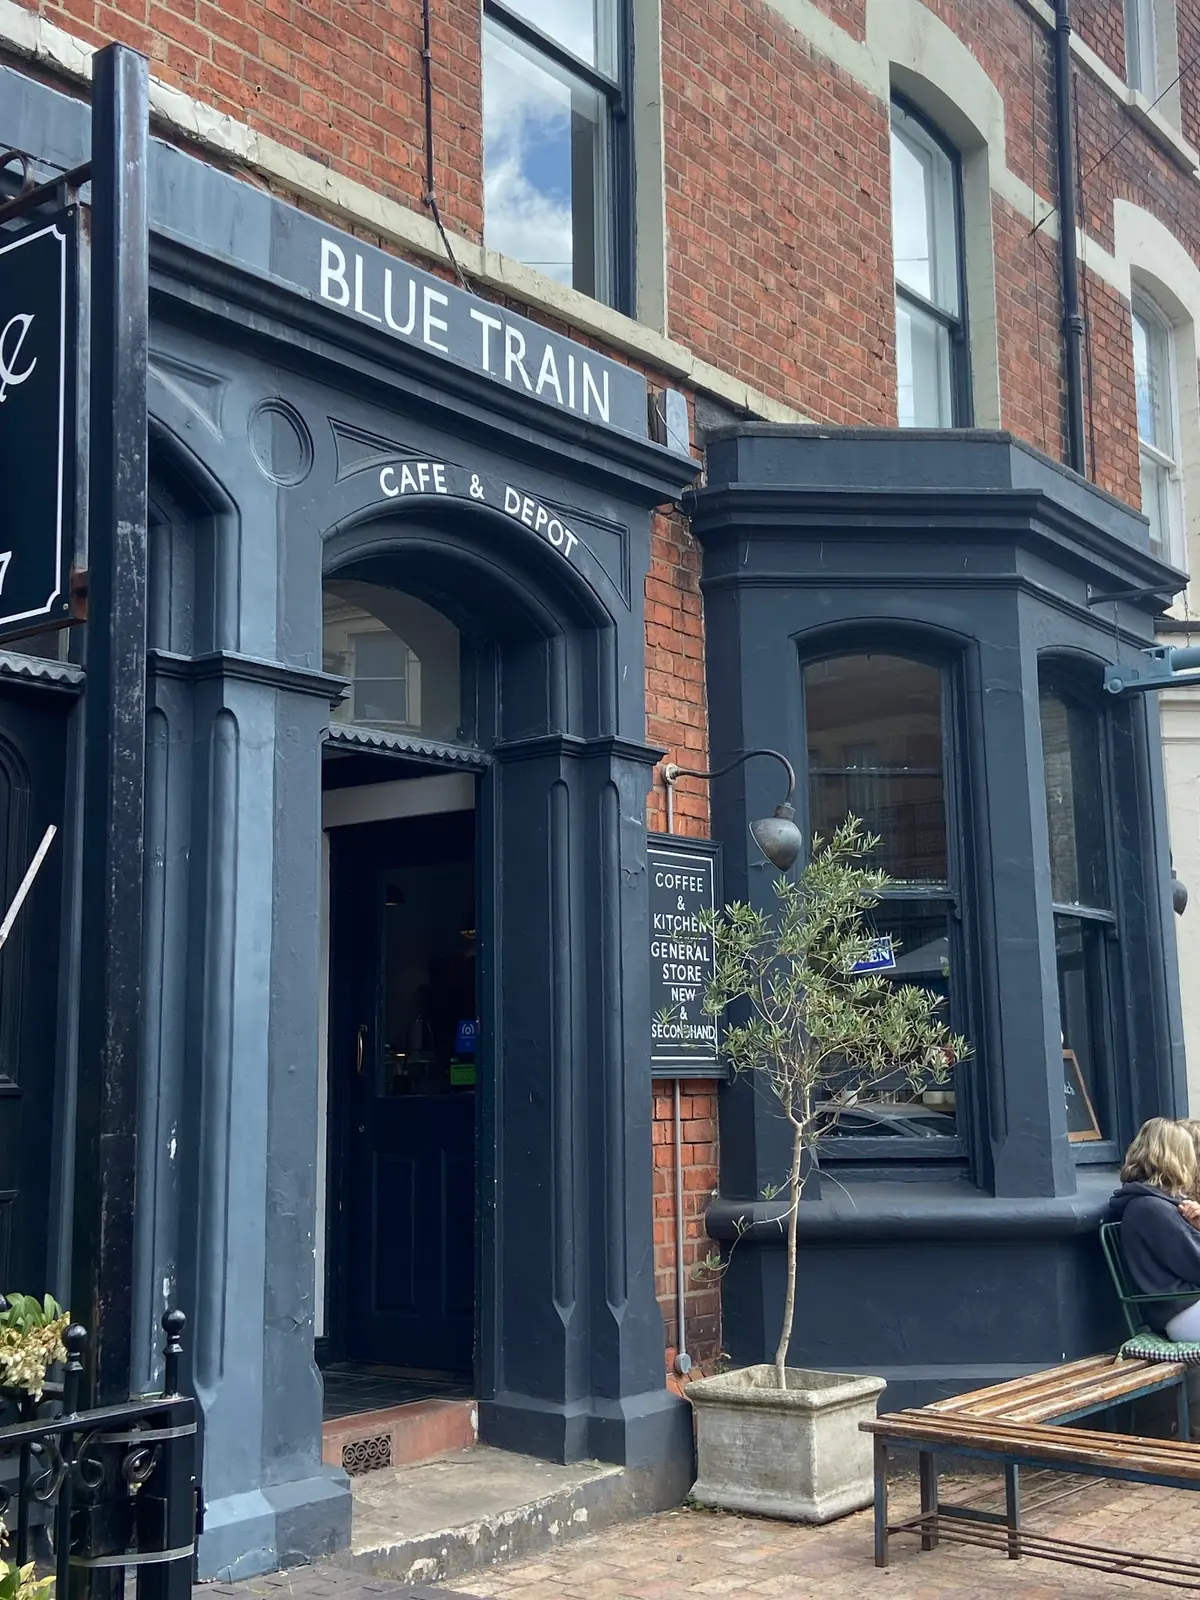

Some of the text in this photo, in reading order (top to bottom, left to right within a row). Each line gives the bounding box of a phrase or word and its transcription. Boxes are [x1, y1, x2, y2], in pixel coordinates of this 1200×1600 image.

[320, 238, 611, 424] BLUE TRAIN
[378, 462, 579, 558] CAFE & DEPOT
[655, 872, 704, 893] COFFEE
[677, 895, 686, 911] &
[651, 941, 710, 962] GENERAL
[662, 963, 702, 982] STORE
[671, 987, 696, 1002] NEW
[679, 1005, 688, 1021] &
